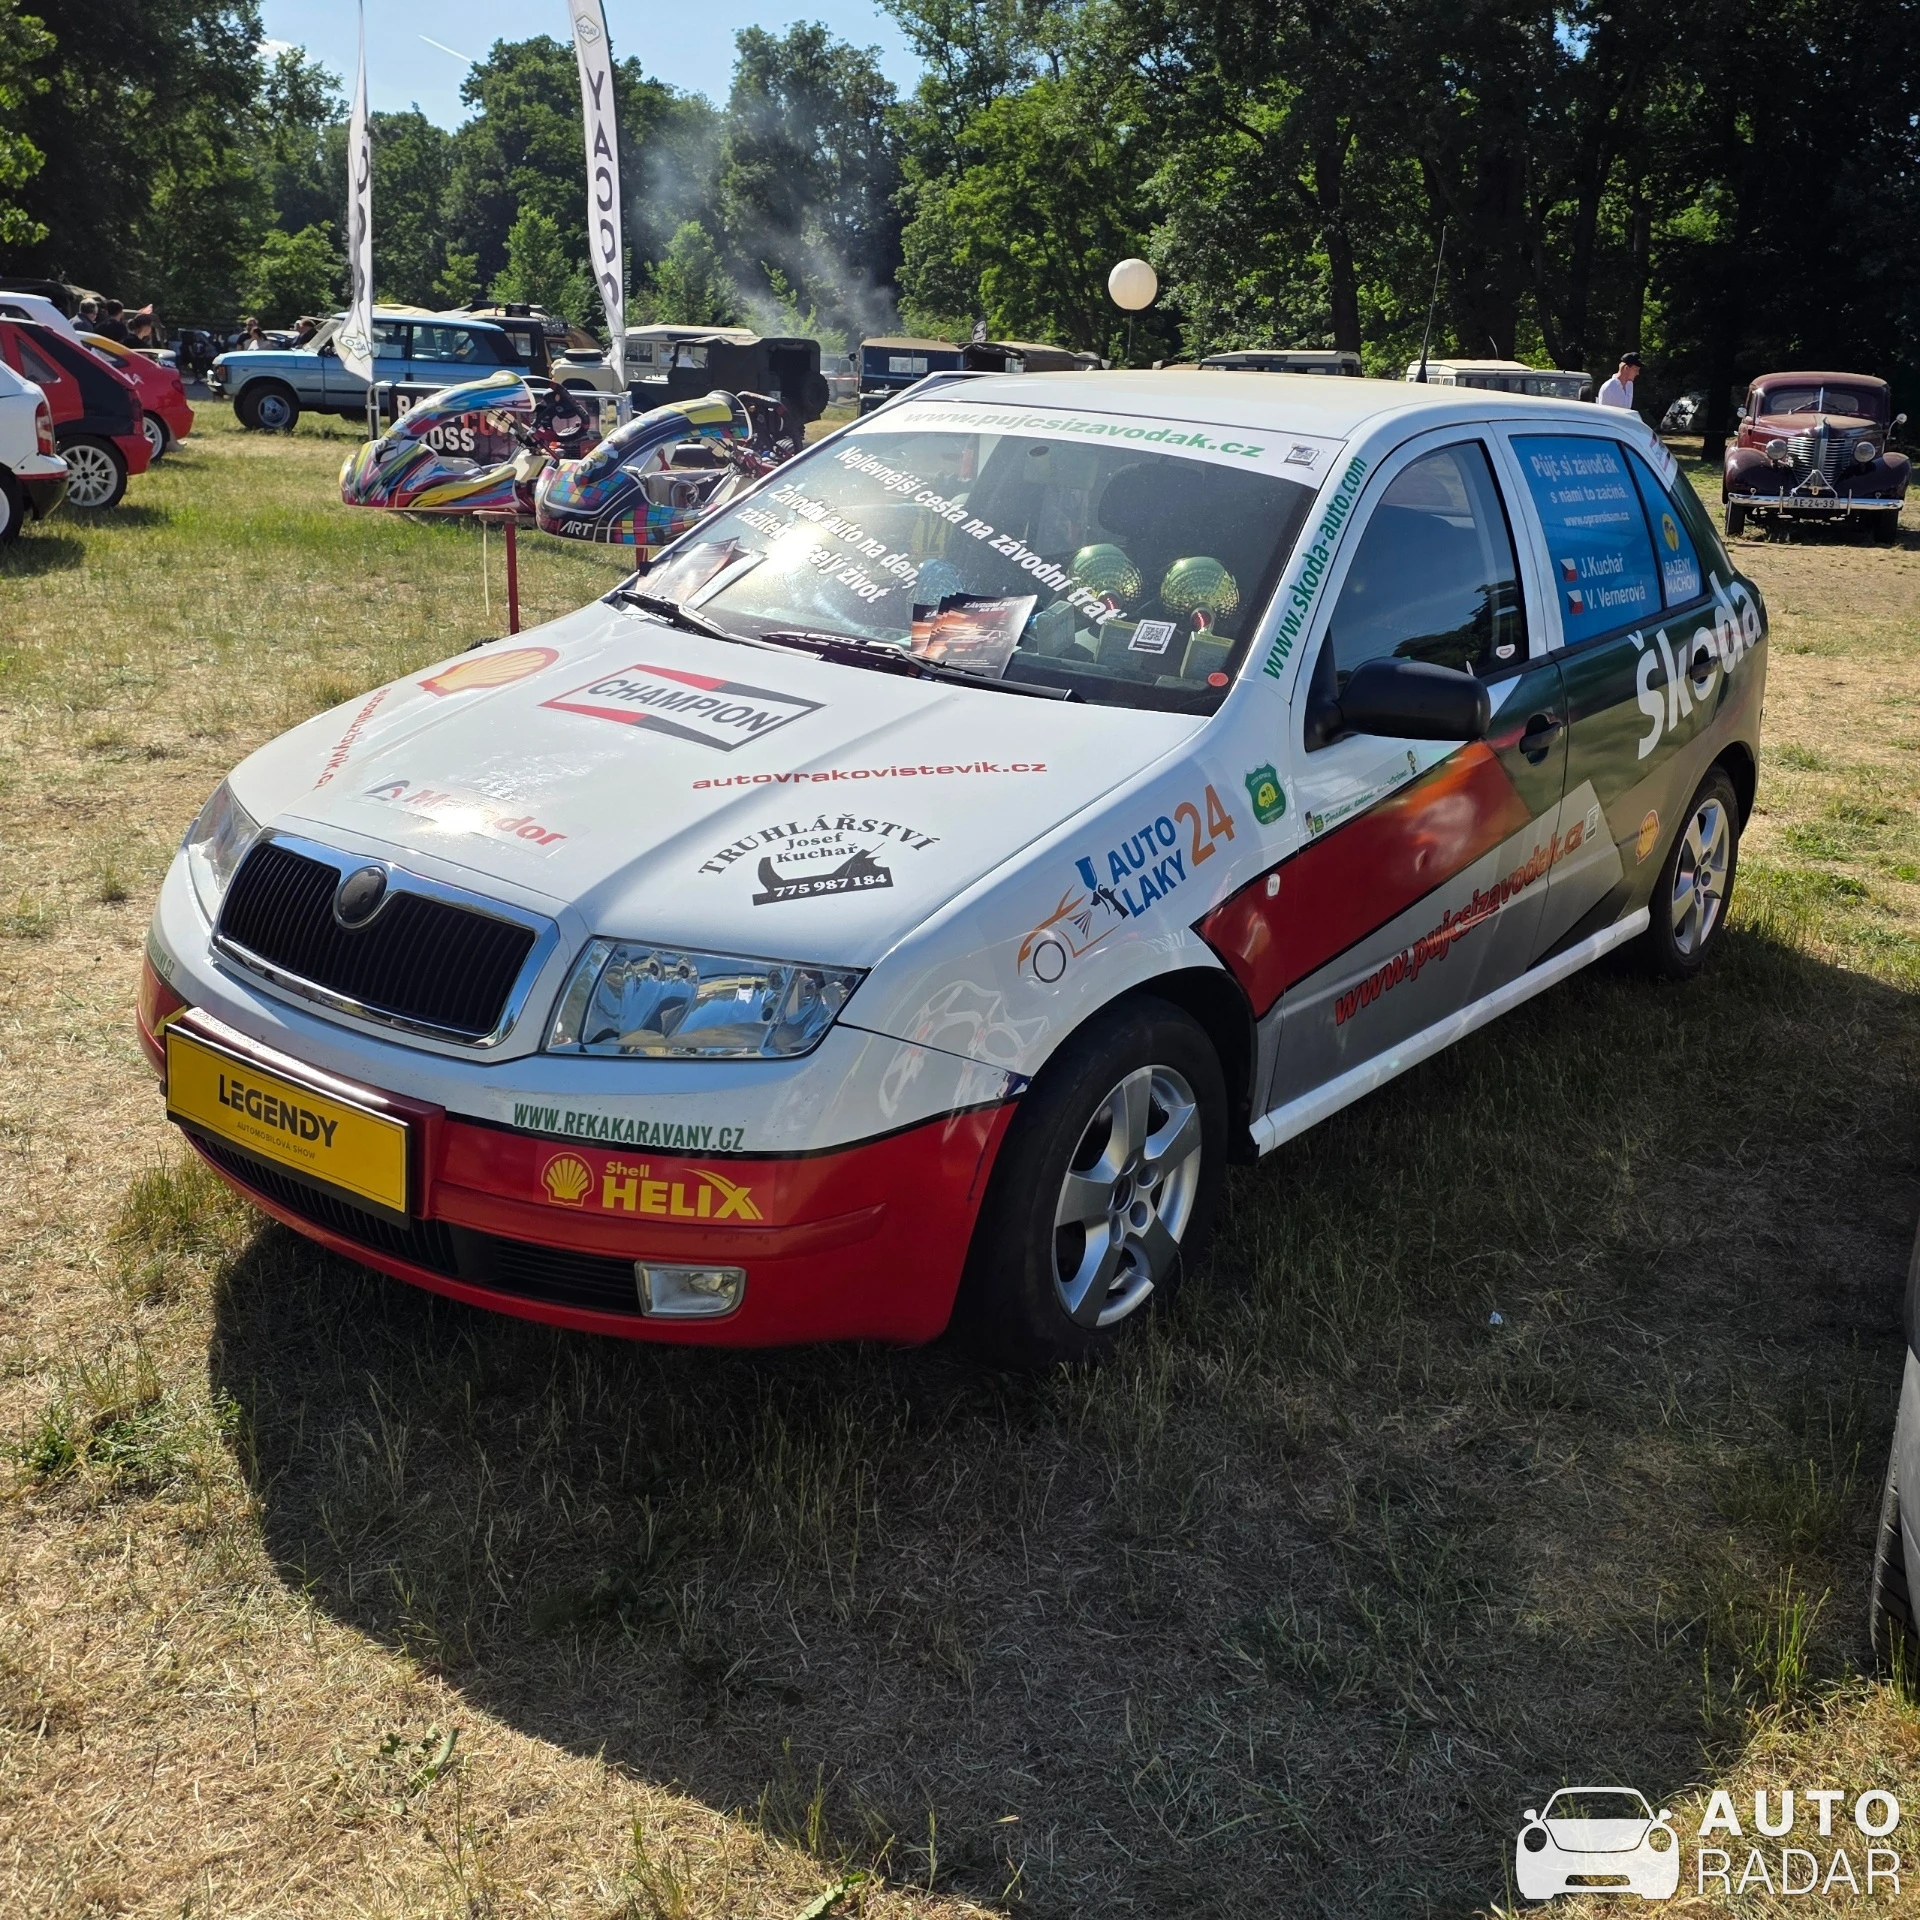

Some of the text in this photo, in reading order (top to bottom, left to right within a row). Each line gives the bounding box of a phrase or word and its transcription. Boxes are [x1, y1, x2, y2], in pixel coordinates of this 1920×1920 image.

[904, 410, 1266, 458] www.pujcsizavodak.cz
[1561, 454, 1573, 476] si
[1559, 487, 1582, 503] námi
[1583, 487, 1596, 502] to
[560, 520, 593, 536] ART
[834, 446, 1128, 626] Nejlevnější cesta na závodní trať
[820, 515, 864, 543] auto
[856, 537, 888, 559] na
[880, 552, 920, 590] den,
[1263, 456, 1368, 680] www.skoda-auto.com
[836, 564, 891, 604] život
[1599, 581, 1646, 608] Vernerová
[1627, 570, 1762, 760] Škoda
[587, 679, 782, 732] CHAMPION
[692, 762, 1047, 789] autovrakovistevik.cz
[698, 813, 940, 875] TRUHLÁŘSTVÍ
[785, 832, 844, 851] Josef
[1174, 784, 1235, 867] 24
[776, 843, 858, 864] Kuchař
[1107, 816, 1176, 885] AUTO
[774, 873, 887, 898] 775 987 184
[1122, 849, 1187, 918] LAKY
[1335, 820, 1584, 1026] www.pujcsizavodak.cz
[219, 1074, 339, 1148] LEGENDY
[514, 1103, 745, 1151] WWW.REKAKARAVANY.CZ
[237, 1121, 316, 1160] AUTOMOBILOVÁ SHOW
[605, 1161, 650, 1178] Shell
[602, 1168, 764, 1220] HELIX
